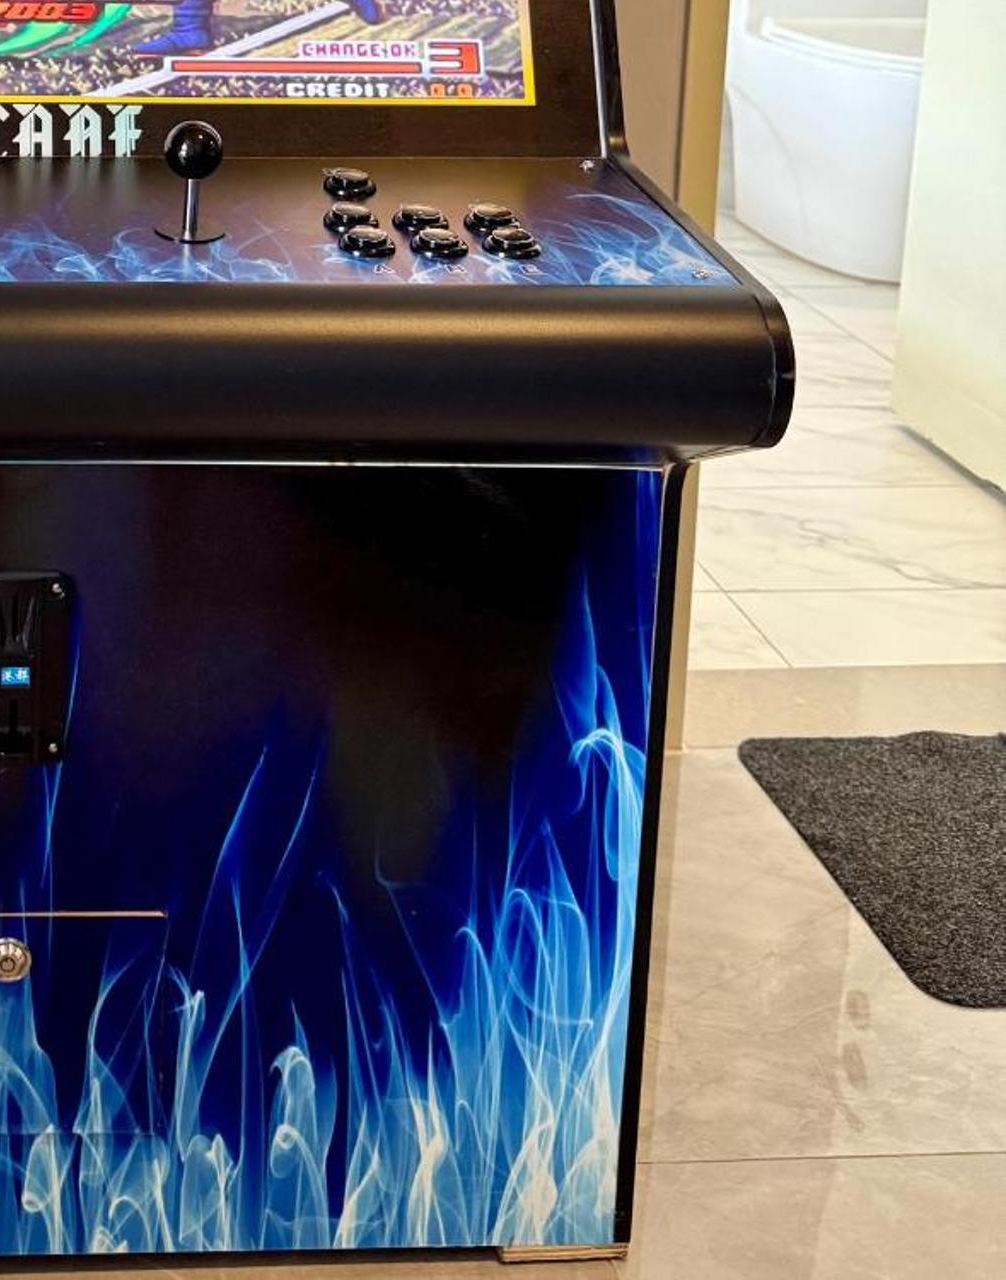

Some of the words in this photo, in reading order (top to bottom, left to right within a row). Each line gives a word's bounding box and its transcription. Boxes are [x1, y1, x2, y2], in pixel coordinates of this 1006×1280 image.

[301, 42, 382, 58] CHANGE
[390, 43, 417, 57] OK
[285, 82, 390, 98] CREDIT
